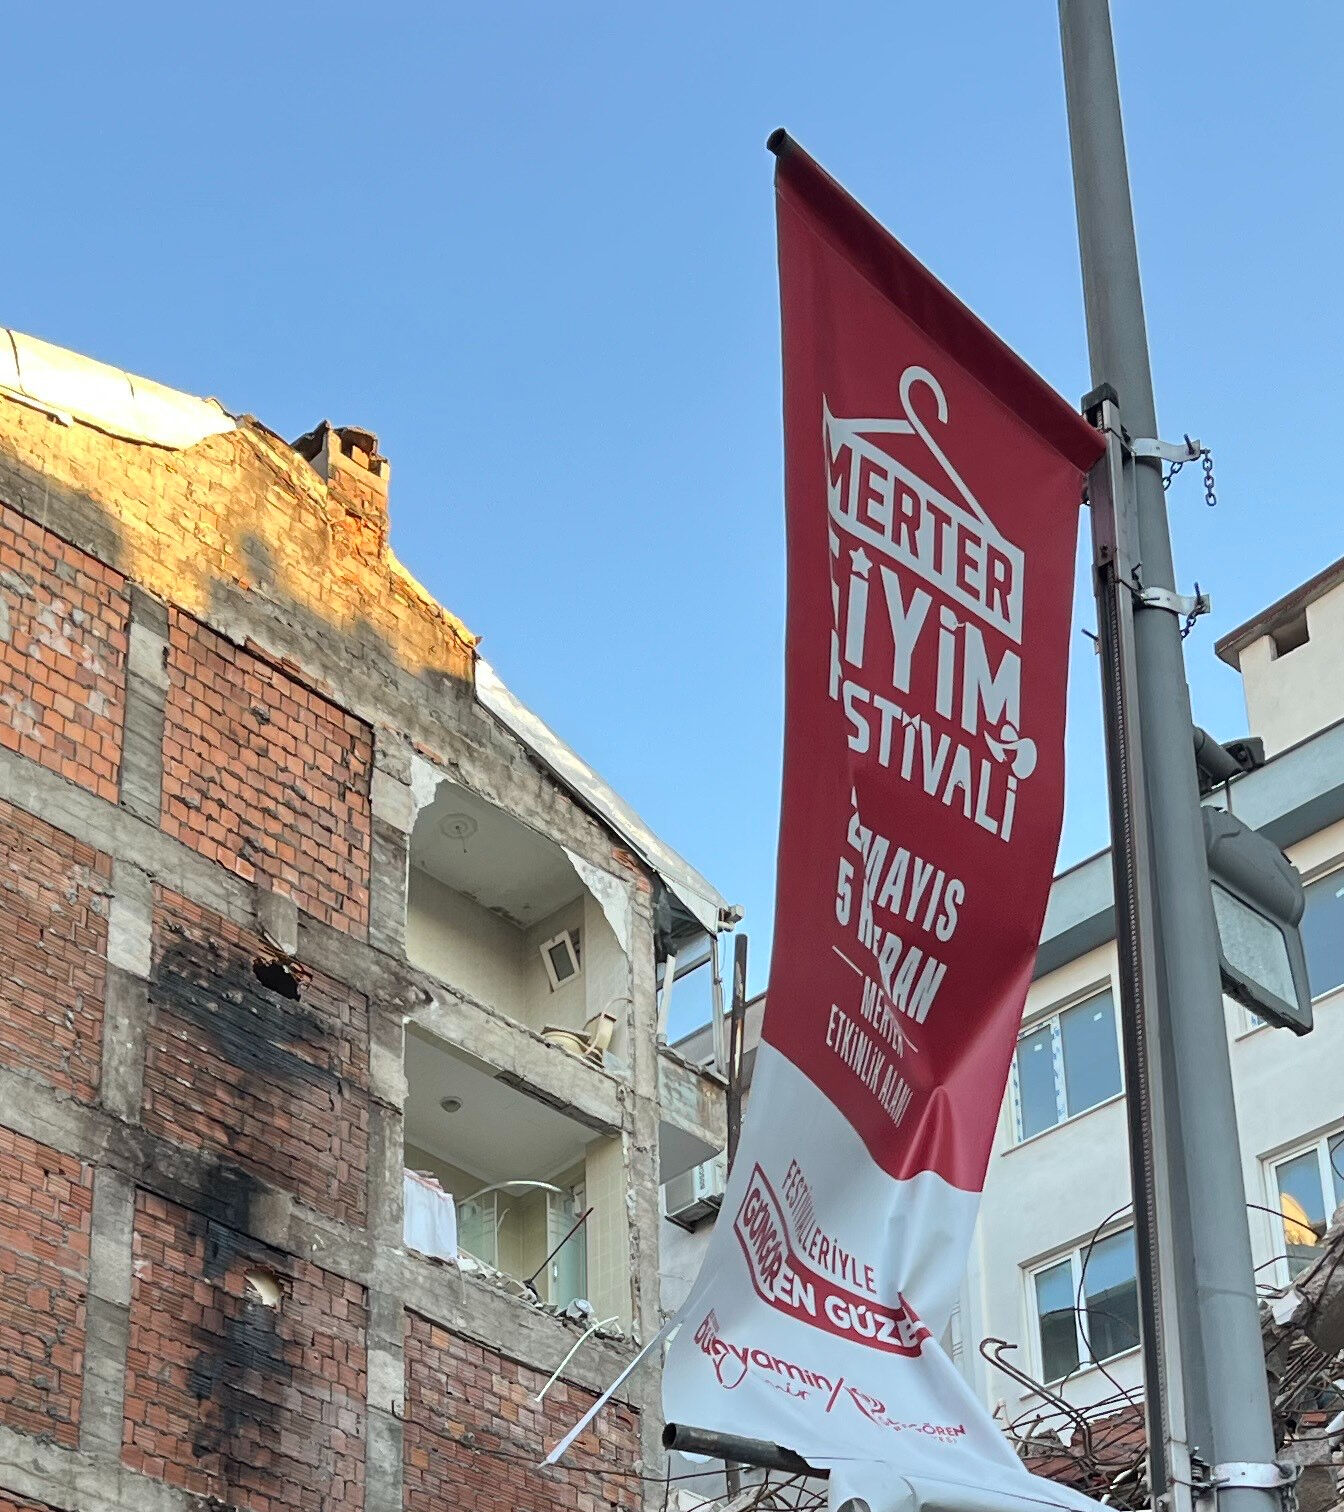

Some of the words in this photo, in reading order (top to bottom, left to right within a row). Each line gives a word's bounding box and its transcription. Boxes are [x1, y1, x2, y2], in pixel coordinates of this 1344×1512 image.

[827, 440, 1014, 625] MERTER
[834, 855, 855, 927] 5
[825, 1003, 886, 1095] ETKİNLİK
